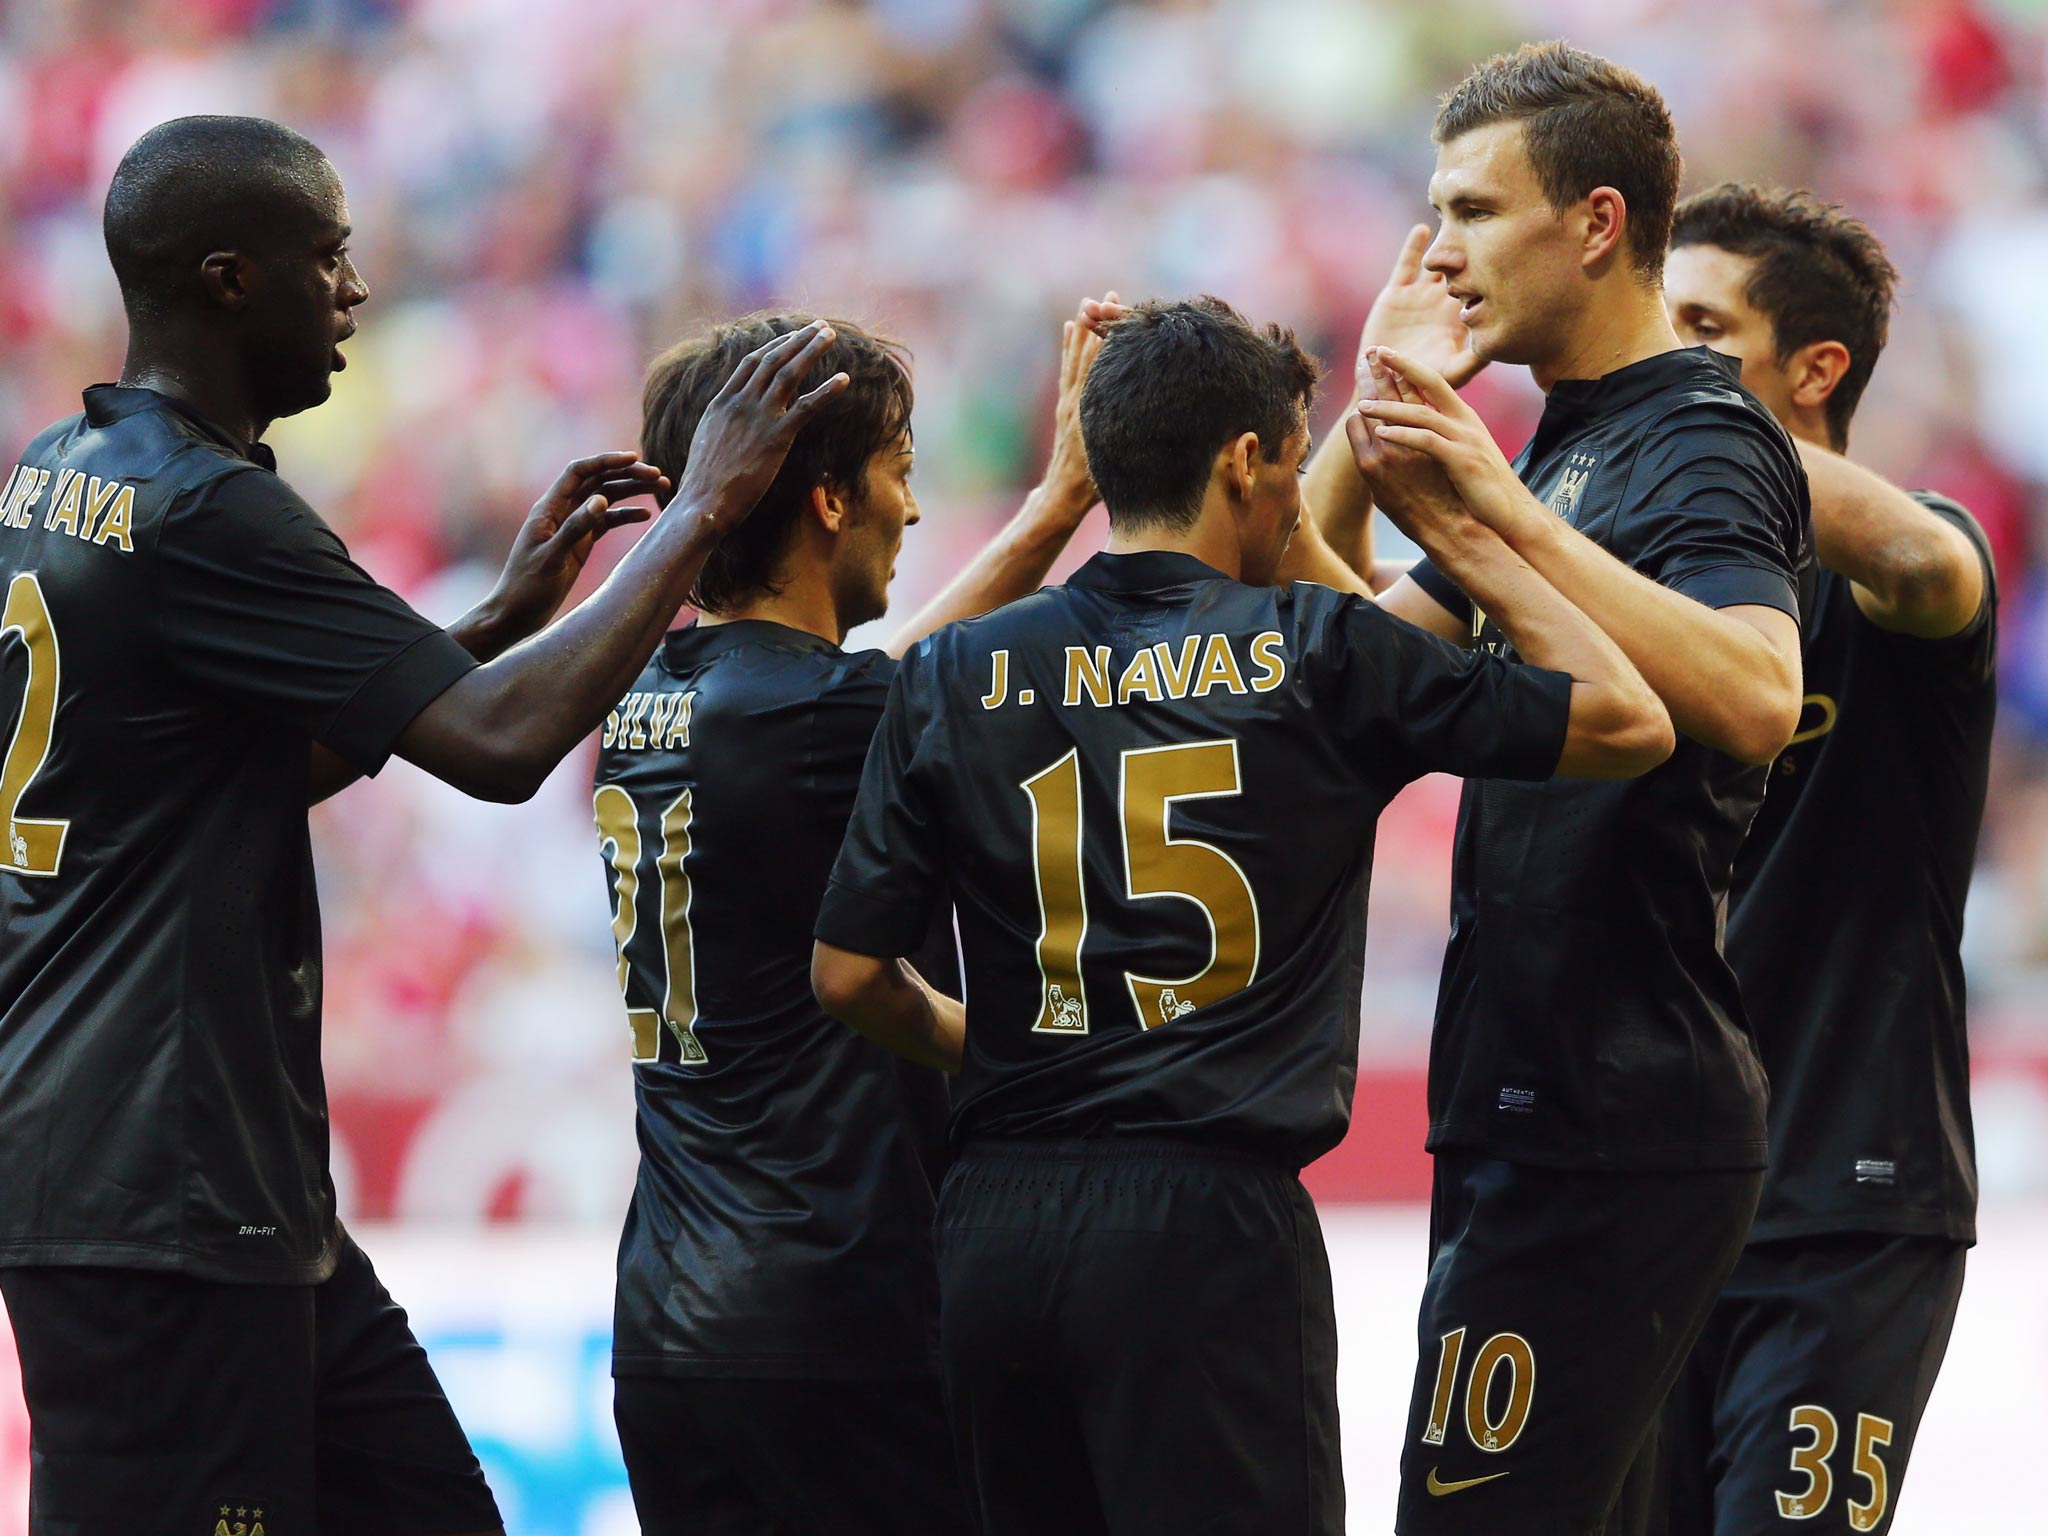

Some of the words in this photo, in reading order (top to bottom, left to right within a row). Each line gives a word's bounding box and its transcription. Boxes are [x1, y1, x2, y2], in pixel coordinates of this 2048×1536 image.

[44, 468, 136, 552] YAYA
[603, 691, 696, 749] SILVA
[981, 650, 1034, 709] J.
[1063, 631, 1285, 708] NAVAS
[593, 784, 708, 1064] 21
[1020, 737, 1260, 1034] 15
[239, 1225, 276, 1236] DRI-FIT
[1422, 1325, 1536, 1453] 10
[1774, 1404, 1894, 1533] 35
